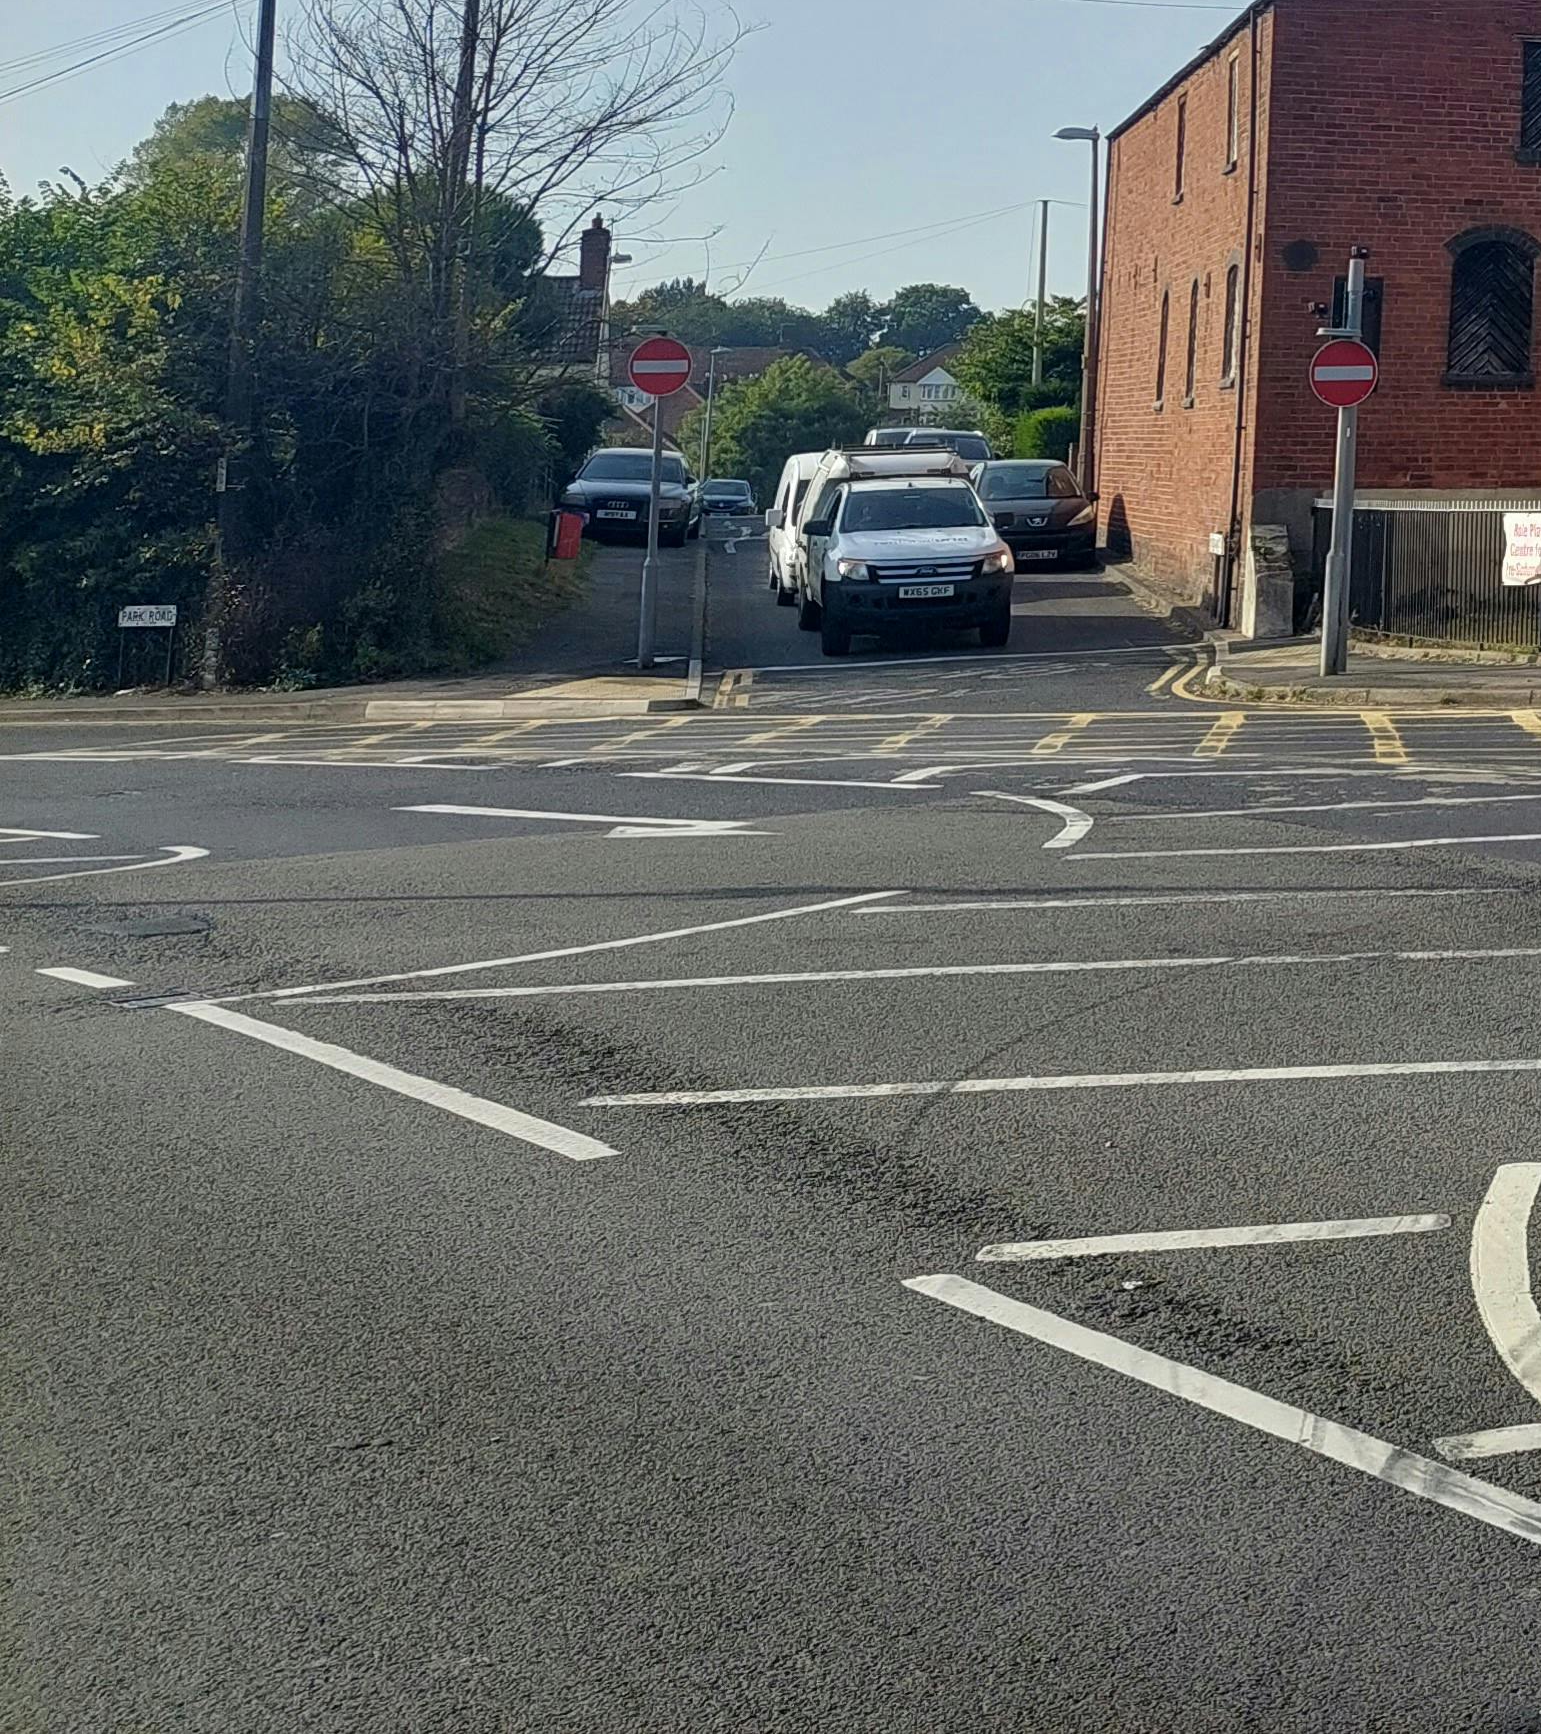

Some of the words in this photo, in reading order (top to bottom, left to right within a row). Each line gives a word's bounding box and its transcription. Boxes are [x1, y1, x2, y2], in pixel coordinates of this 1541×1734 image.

[903, 586, 929, 597] WX65
[931, 586, 950, 596] GKF
[122, 610, 145, 622] PARK
[149, 610, 173, 623] ROAD
